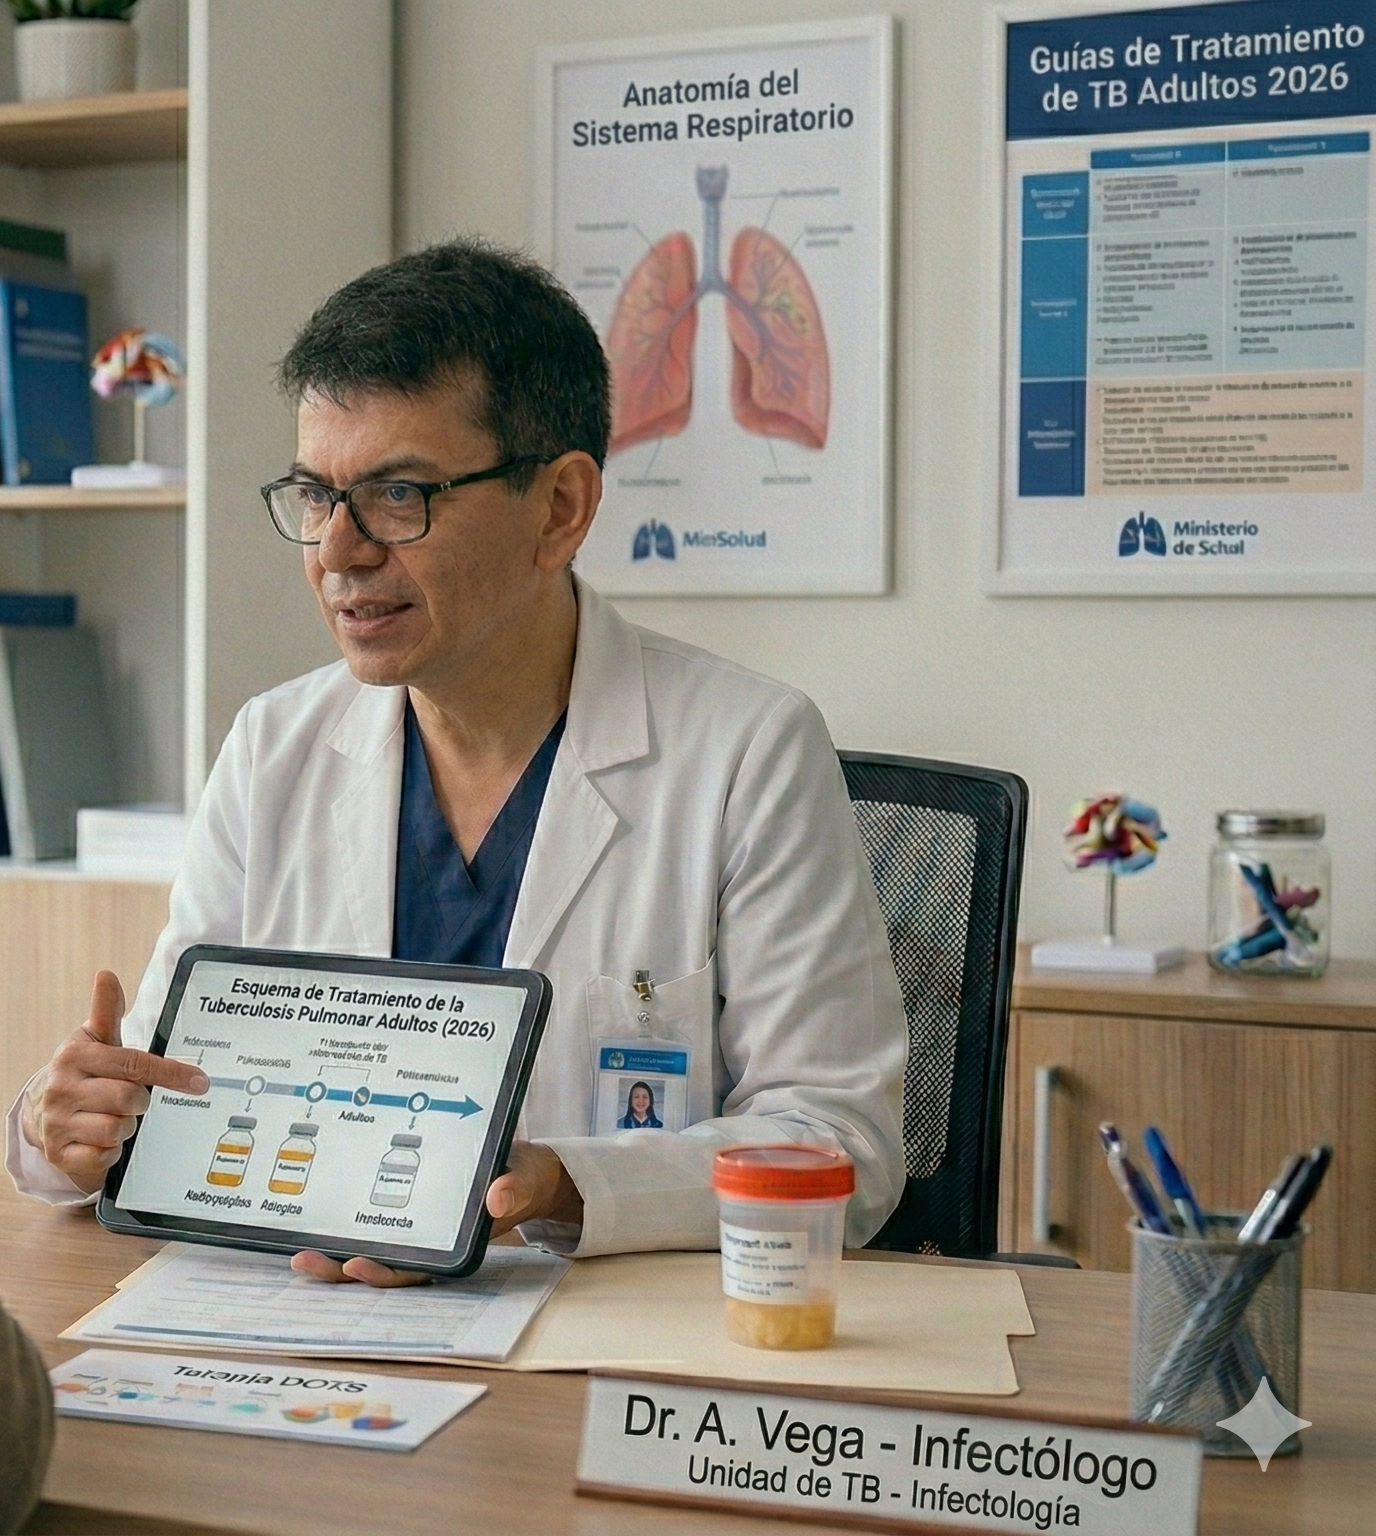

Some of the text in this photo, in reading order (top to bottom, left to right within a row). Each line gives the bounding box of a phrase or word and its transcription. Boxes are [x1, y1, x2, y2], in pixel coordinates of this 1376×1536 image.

[1030, 23, 1365, 74] Guías de Tratamiento
[623, 68, 799, 107] Anatomía del
[1042, 62, 1349, 112] de TB Adultos 2026
[573, 103, 855, 147] Sistema Respiratorio
[1173, 520, 1259, 536] Ministerio
[1173, 540, 1195, 555] de
[231, 978, 465, 1013] Esquema de Tratamiento de la
[199, 997, 496, 1041] Tuberculosis Pulmonar Adultos (2026)
[624, 1393, 1158, 1499] Dr. A. Vega - Infectólogo
[688, 1454, 787, 1493] Unidad
[796, 1468, 831, 1498] de
[841, 1472, 881, 1504] TB
[912, 1479, 1081, 1531] Infectología
